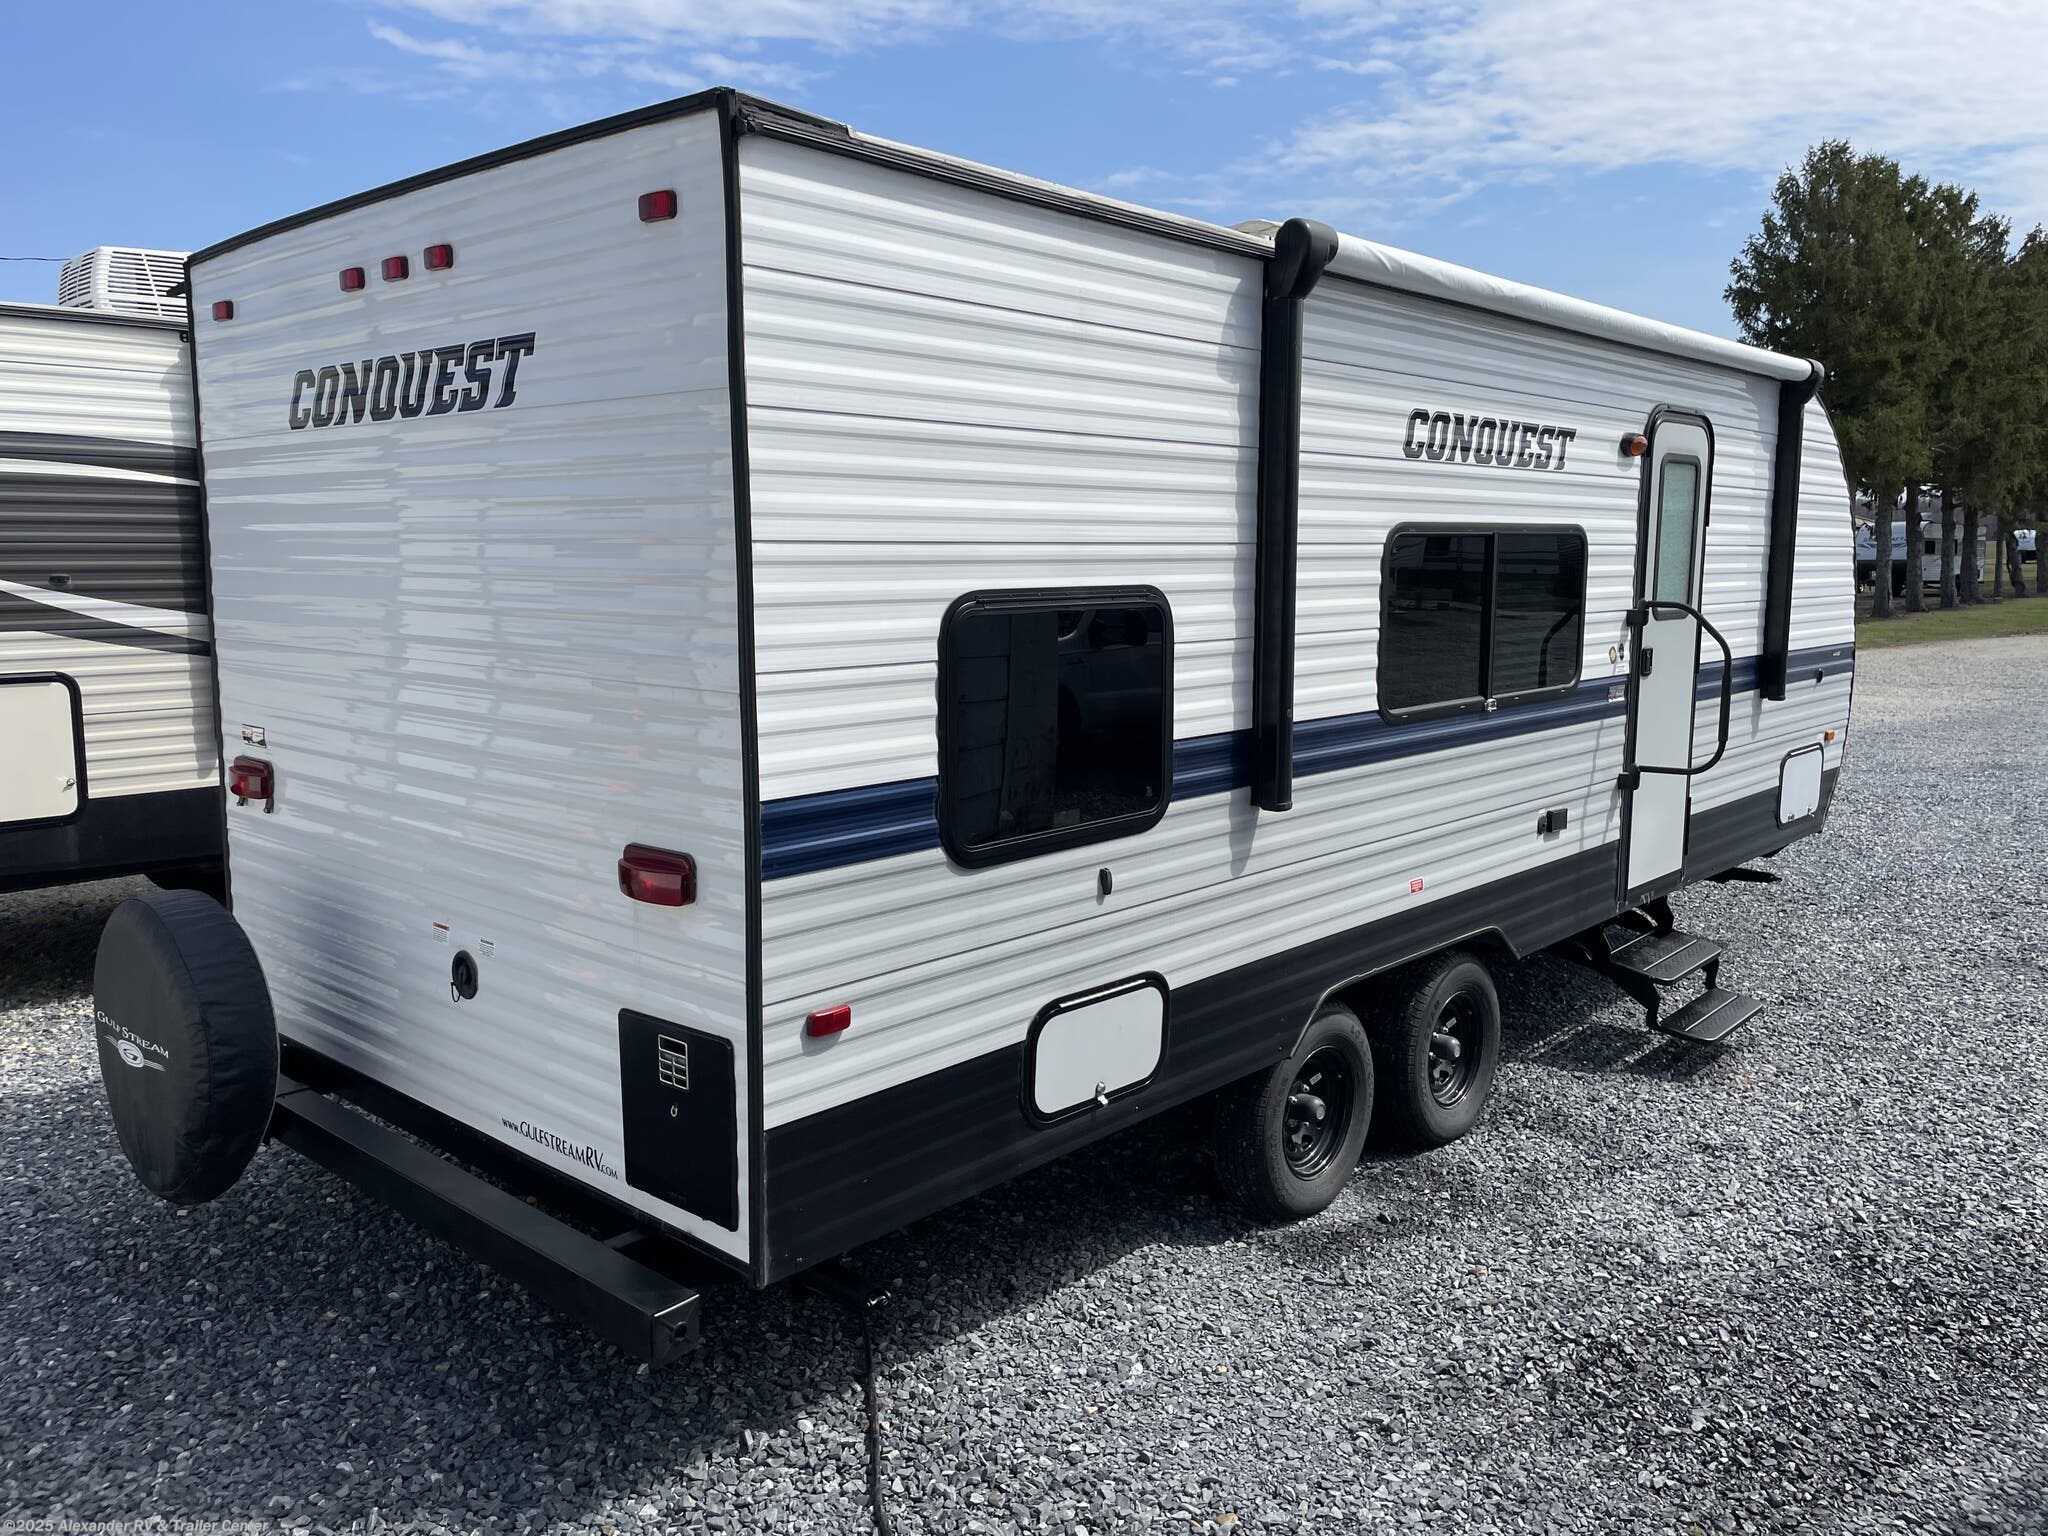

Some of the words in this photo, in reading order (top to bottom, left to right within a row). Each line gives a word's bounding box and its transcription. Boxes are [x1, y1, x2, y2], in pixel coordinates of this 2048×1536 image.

[289, 332, 536, 430] CONQUEST
[1403, 408, 1577, 470] CONQUEST
[121, 1026, 169, 1059] STREAM
